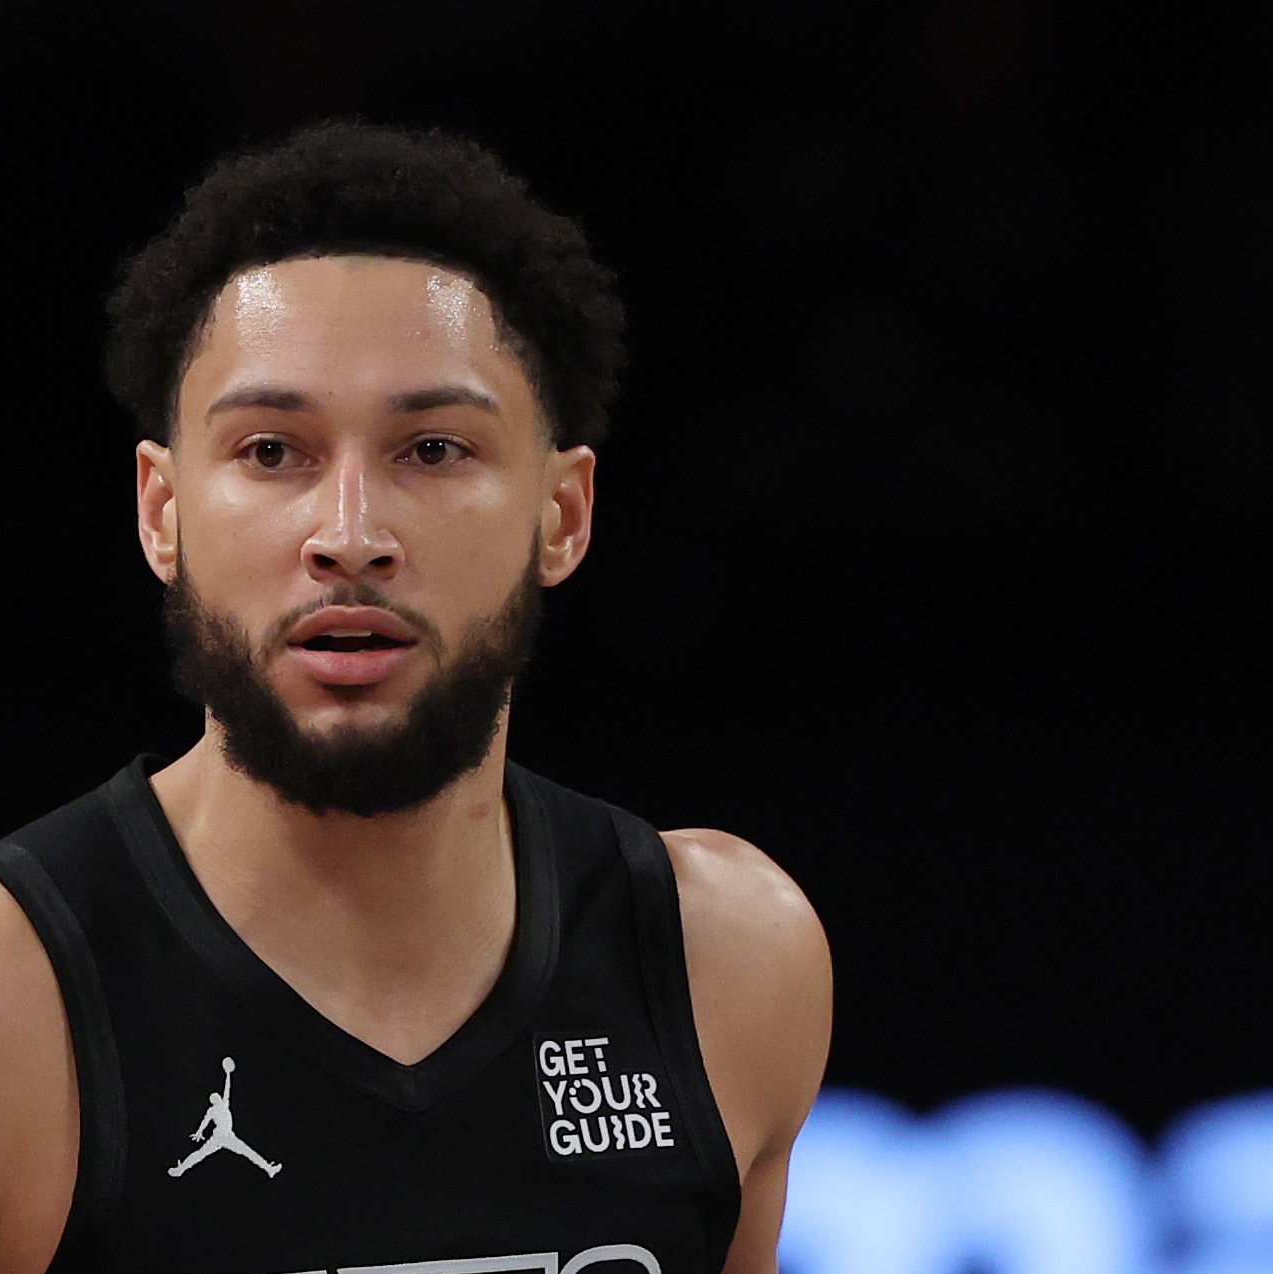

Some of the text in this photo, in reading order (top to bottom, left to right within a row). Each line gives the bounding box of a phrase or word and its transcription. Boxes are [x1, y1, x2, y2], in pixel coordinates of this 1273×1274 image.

[539, 1037, 609, 1077] GET
[542, 1073, 662, 1115] YOUR
[549, 1111, 675, 1156] GUIDE
